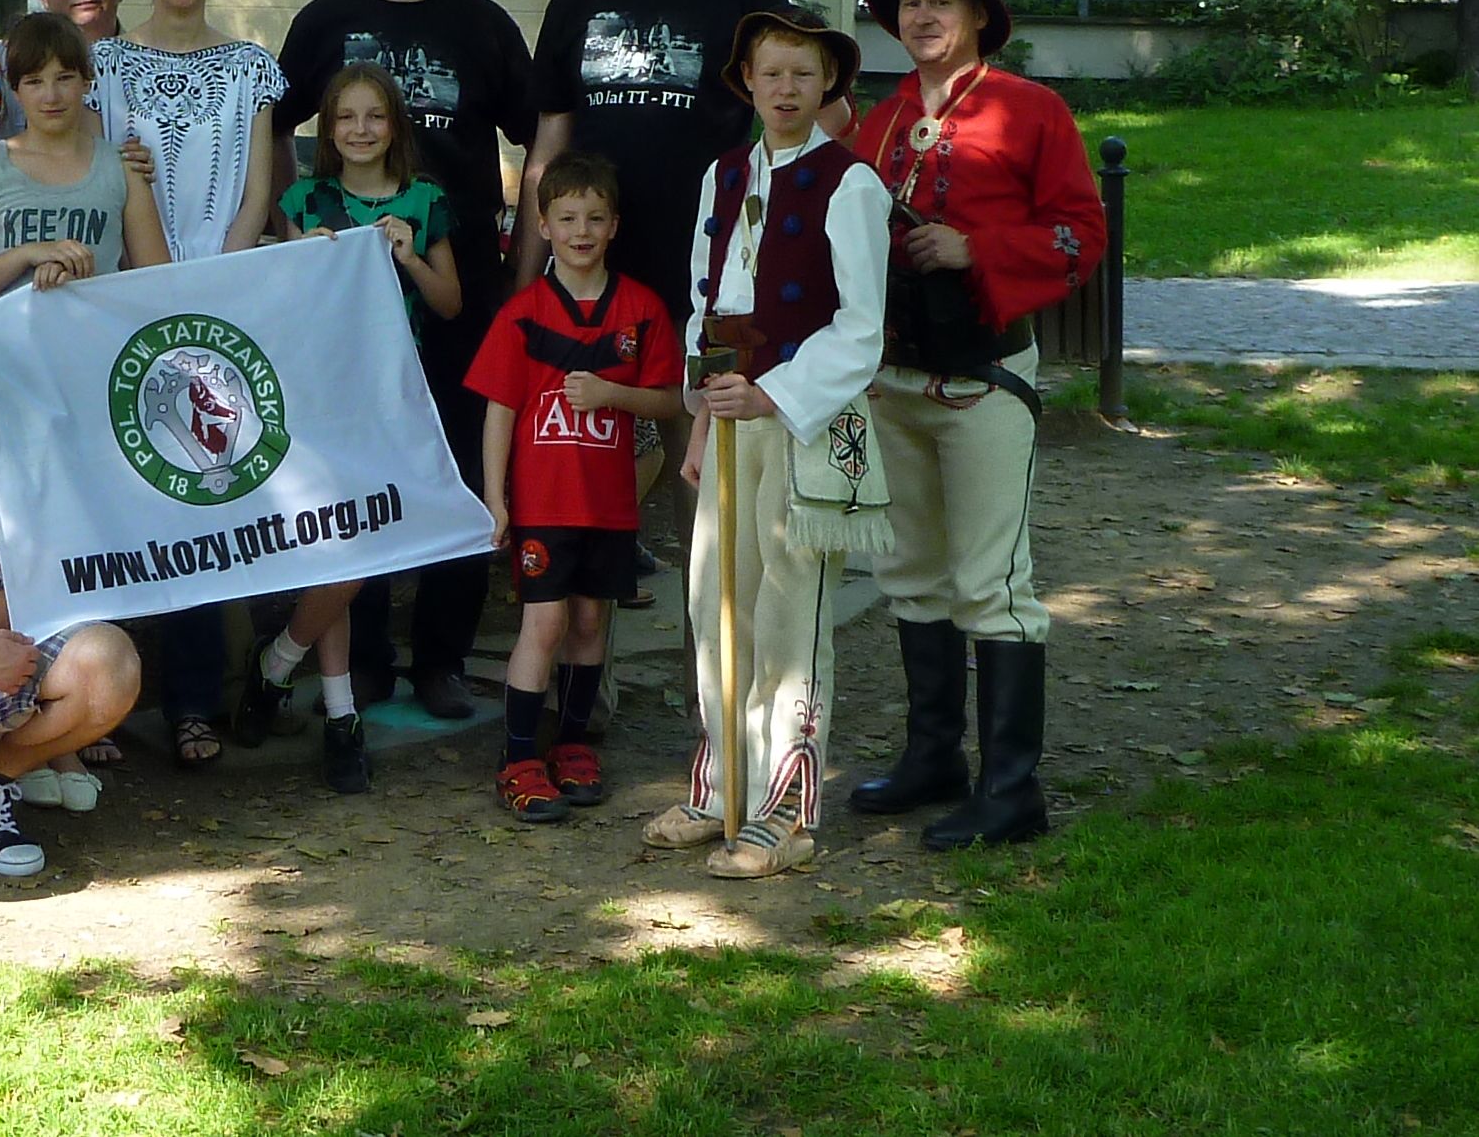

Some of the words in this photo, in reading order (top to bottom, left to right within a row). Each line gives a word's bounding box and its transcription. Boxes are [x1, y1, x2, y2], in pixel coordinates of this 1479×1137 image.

[605, 90, 624, 104] lat
[627, 90, 649, 104] TT
[661, 91, 695, 109] PTT
[115, 338, 157, 392] TOW.
[119, 404, 153, 467] POL.
[539, 395, 615, 440] AIG
[168, 474, 189, 495] 18
[243, 454, 269, 480] 73
[60, 483, 403, 594] www.kozy.ptt.org.pl
